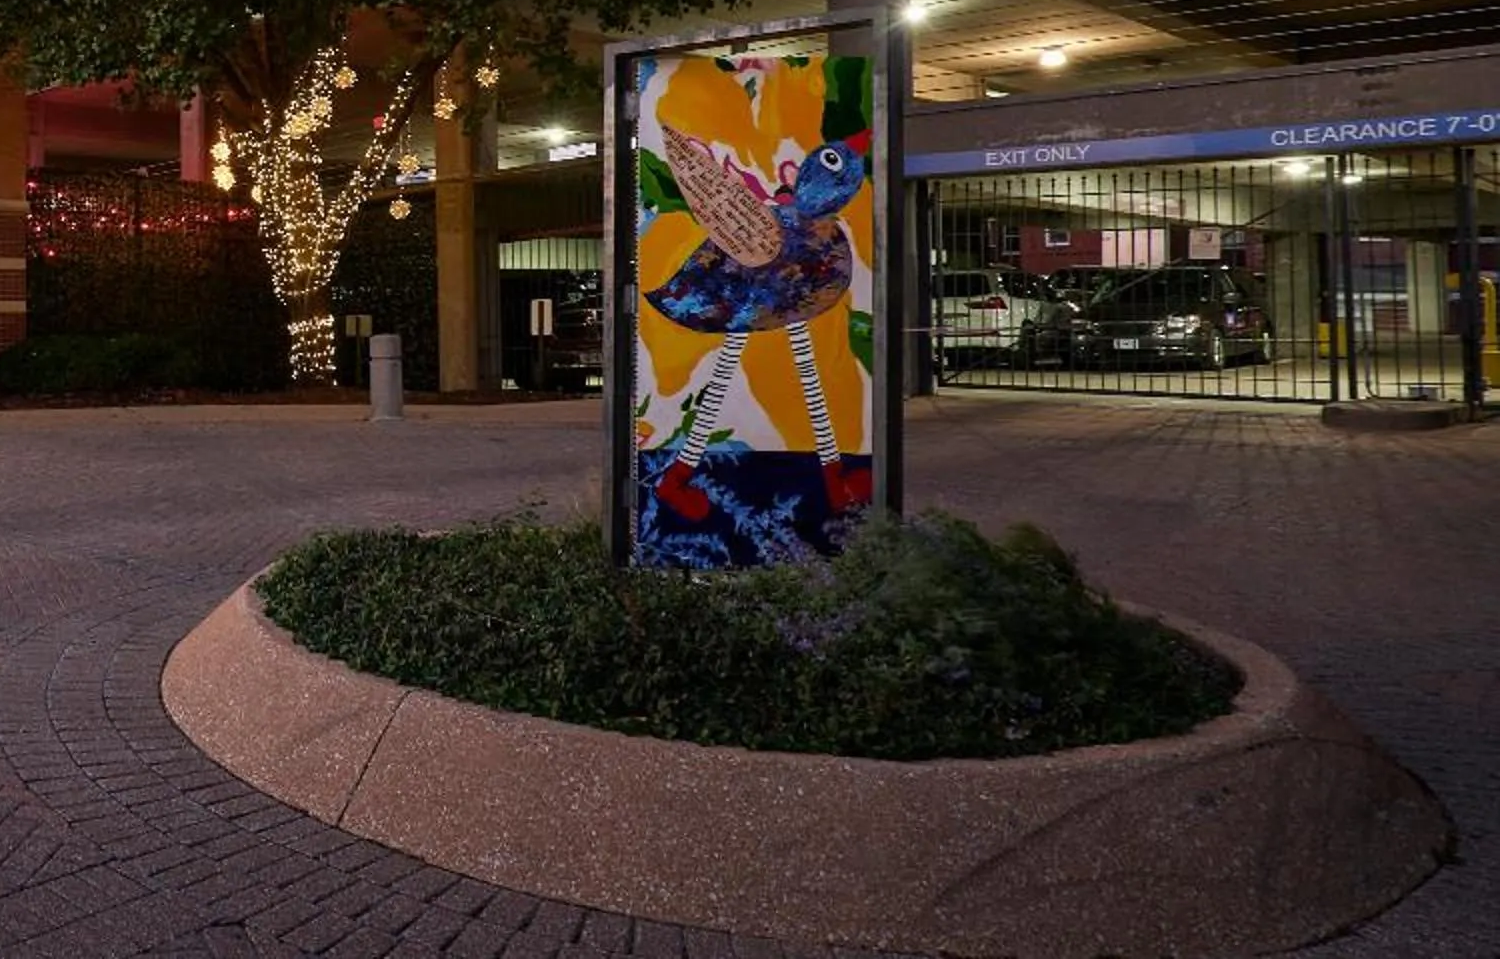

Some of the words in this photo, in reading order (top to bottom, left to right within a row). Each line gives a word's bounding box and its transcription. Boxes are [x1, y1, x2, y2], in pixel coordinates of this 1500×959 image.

[1271, 118, 1436, 147] CLEARANCE
[985, 150, 1025, 166] EXIT
[1035, 144, 1091, 162] ONLY
